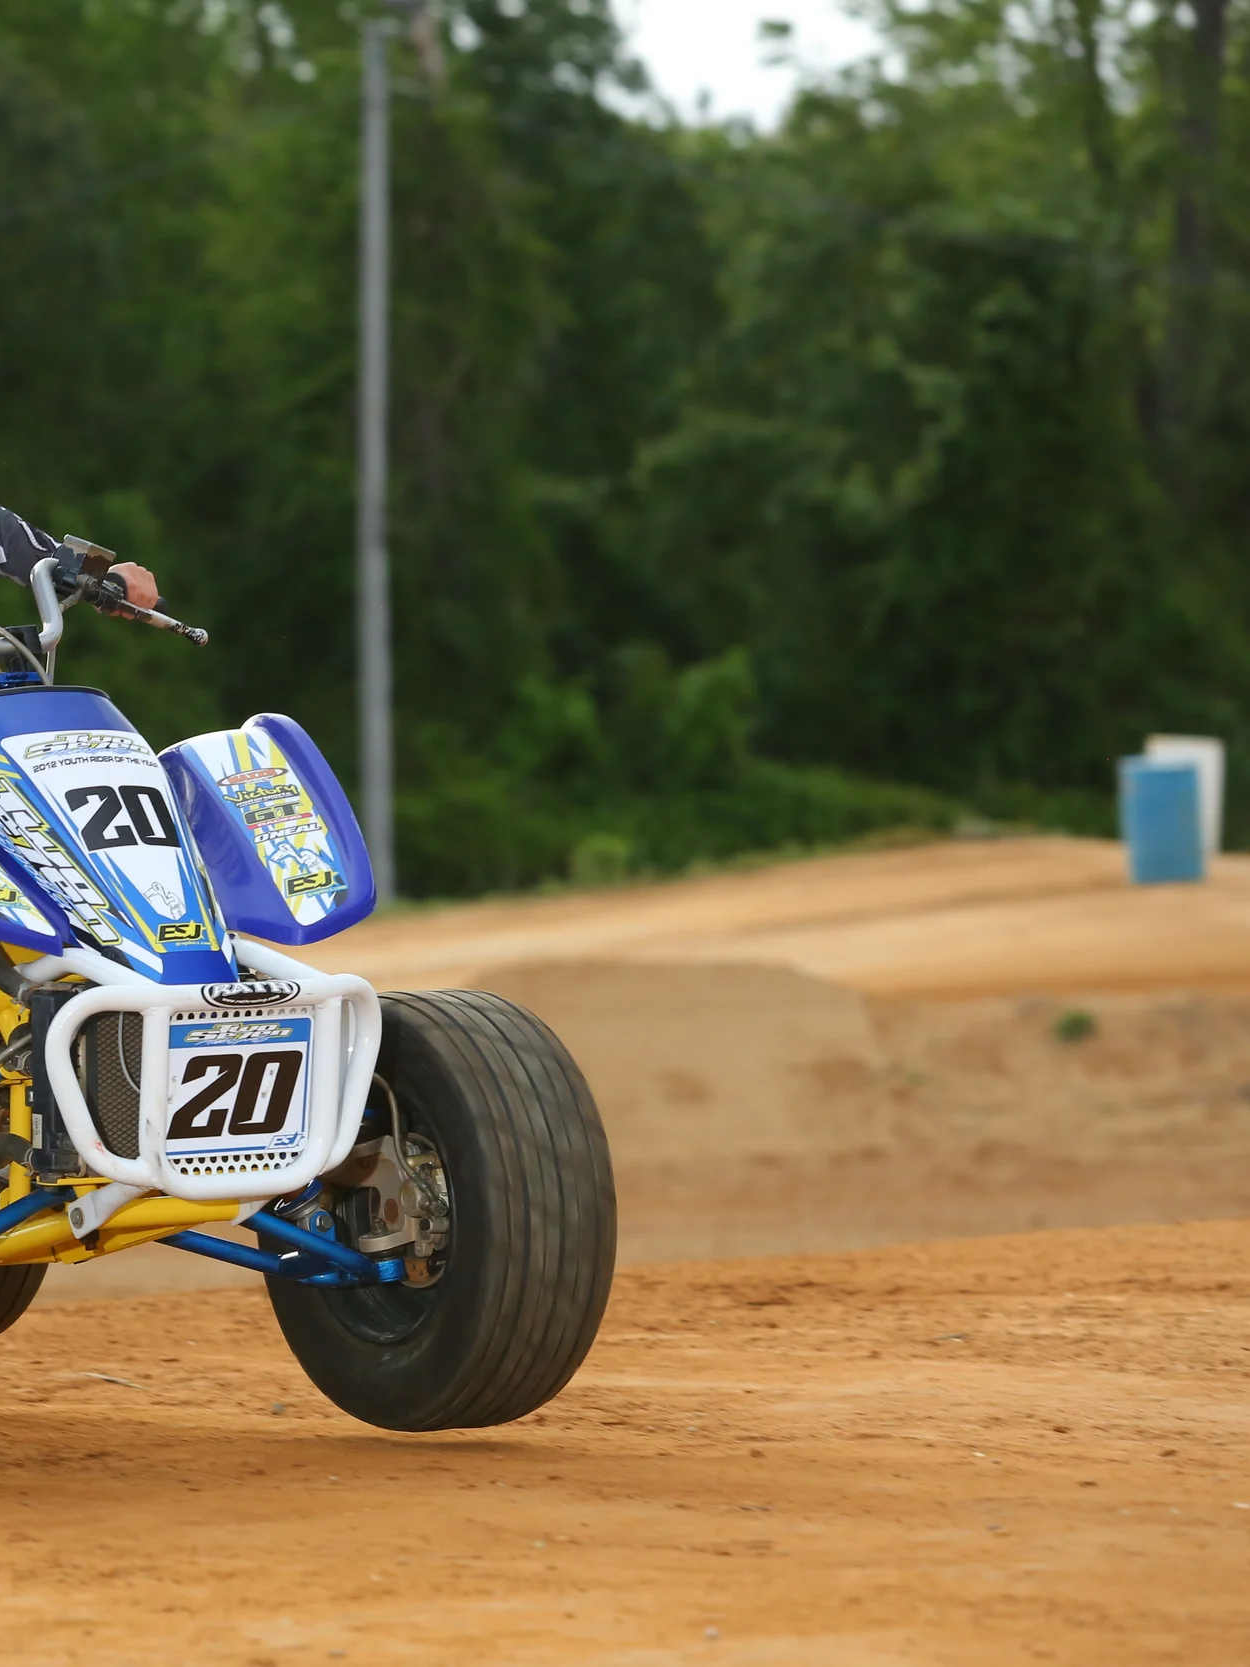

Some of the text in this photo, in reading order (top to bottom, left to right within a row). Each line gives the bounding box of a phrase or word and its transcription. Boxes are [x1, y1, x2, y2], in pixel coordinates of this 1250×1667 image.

[33, 762, 57, 773] 2012
[59, 757, 89, 767] YOUTH
[125, 757, 140, 765] THE
[223, 785, 299, 803] Victory
[65, 785, 181, 851] 20
[243, 801, 303, 825] GT
[287, 870, 333, 895] ESJ
[158, 923, 203, 942] ESJ
[211, 980, 292, 998] RATH
[166, 1050, 303, 1140] 20
[270, 1134, 306, 1149] ESJ
